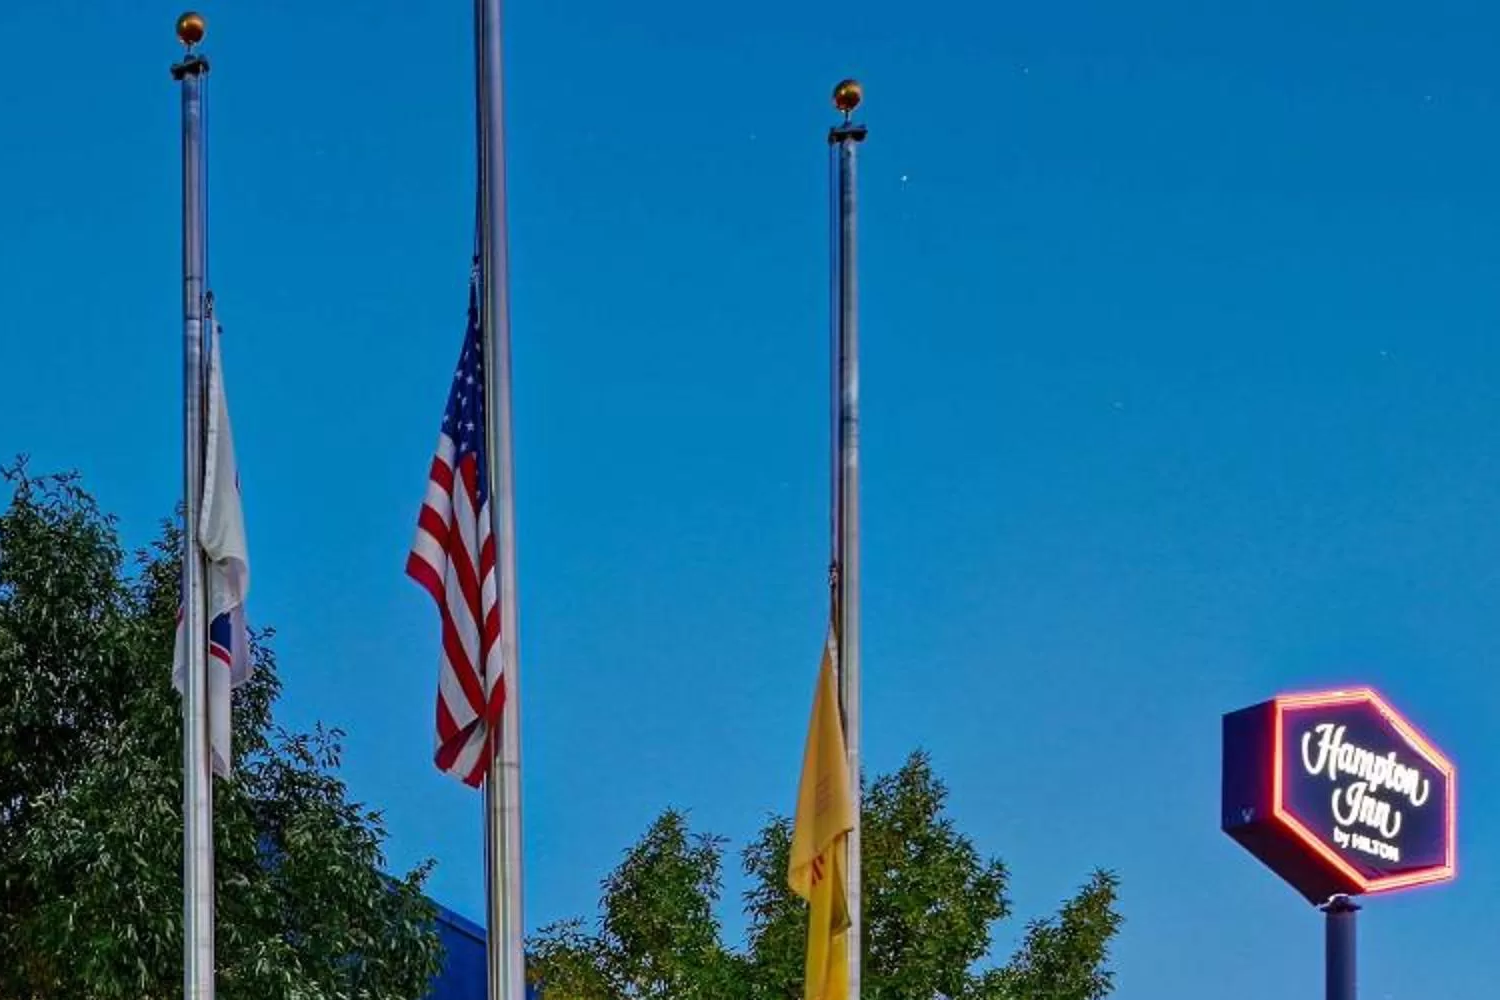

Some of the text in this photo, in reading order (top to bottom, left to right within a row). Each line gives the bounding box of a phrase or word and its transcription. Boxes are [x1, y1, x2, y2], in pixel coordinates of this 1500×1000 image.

[1301, 722, 1430, 807] Hampton
[1331, 781, 1401, 838] Inn
[1333, 826, 1350, 849] by
